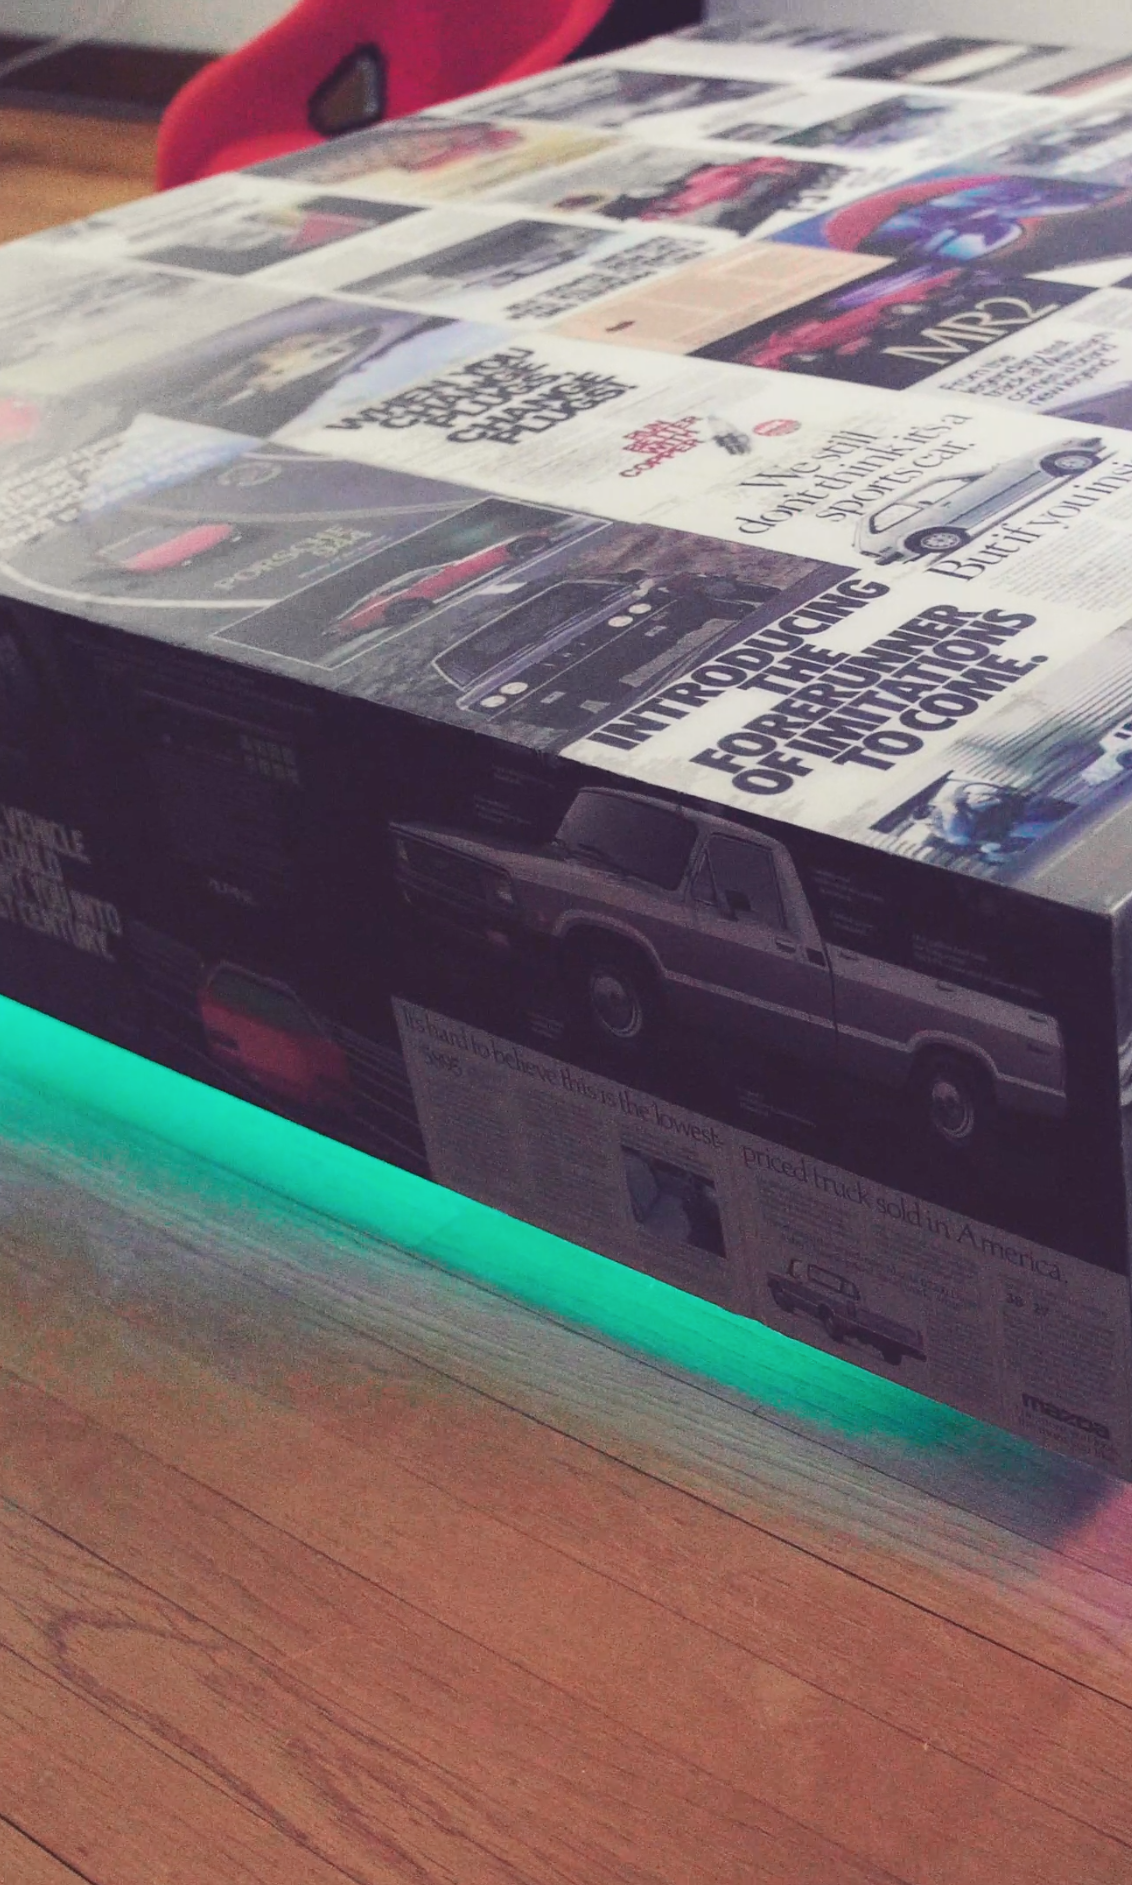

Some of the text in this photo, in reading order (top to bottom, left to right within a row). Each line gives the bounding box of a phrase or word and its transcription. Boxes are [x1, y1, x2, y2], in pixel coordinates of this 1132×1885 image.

[882, 296, 1060, 365] MR2
[325, 348, 534, 430] WHEN YOU
[371, 359, 553, 430] CHANGE
[446, 372, 615, 444] CHANGE
[618, 438, 704, 478] COPPER
[733, 490, 829, 535] don't
[813, 446, 916, 491] think
[940, 414, 972, 425] a
[738, 430, 879, 489] We still
[815, 440, 976, 519] sports car.
[925, 542, 1020, 581] But
[991, 522, 1043, 544] if
[1026, 493, 1101, 530] you
[586, 579, 890, 751] INTRODUCING
[689, 604, 982, 774] FORERUNNER
[731, 608, 1036, 796] OF IMITATIONS
[736, 643, 851, 696] THE
[831, 653, 1048, 771] TO COME.
[492, 1042, 557, 1086] believe
[560, 1064, 596, 1101] this
[599, 1086, 616, 1109] is
[618, 1088, 649, 1123] the
[742, 1139, 808, 1190] priced
[813, 1166, 871, 1209] truck
[875, 1189, 923, 1229] sold
[926, 1210, 950, 1240] in
[955, 1220, 1068, 1286] America.
[1021, 1391, 1110, 1442] mazda
